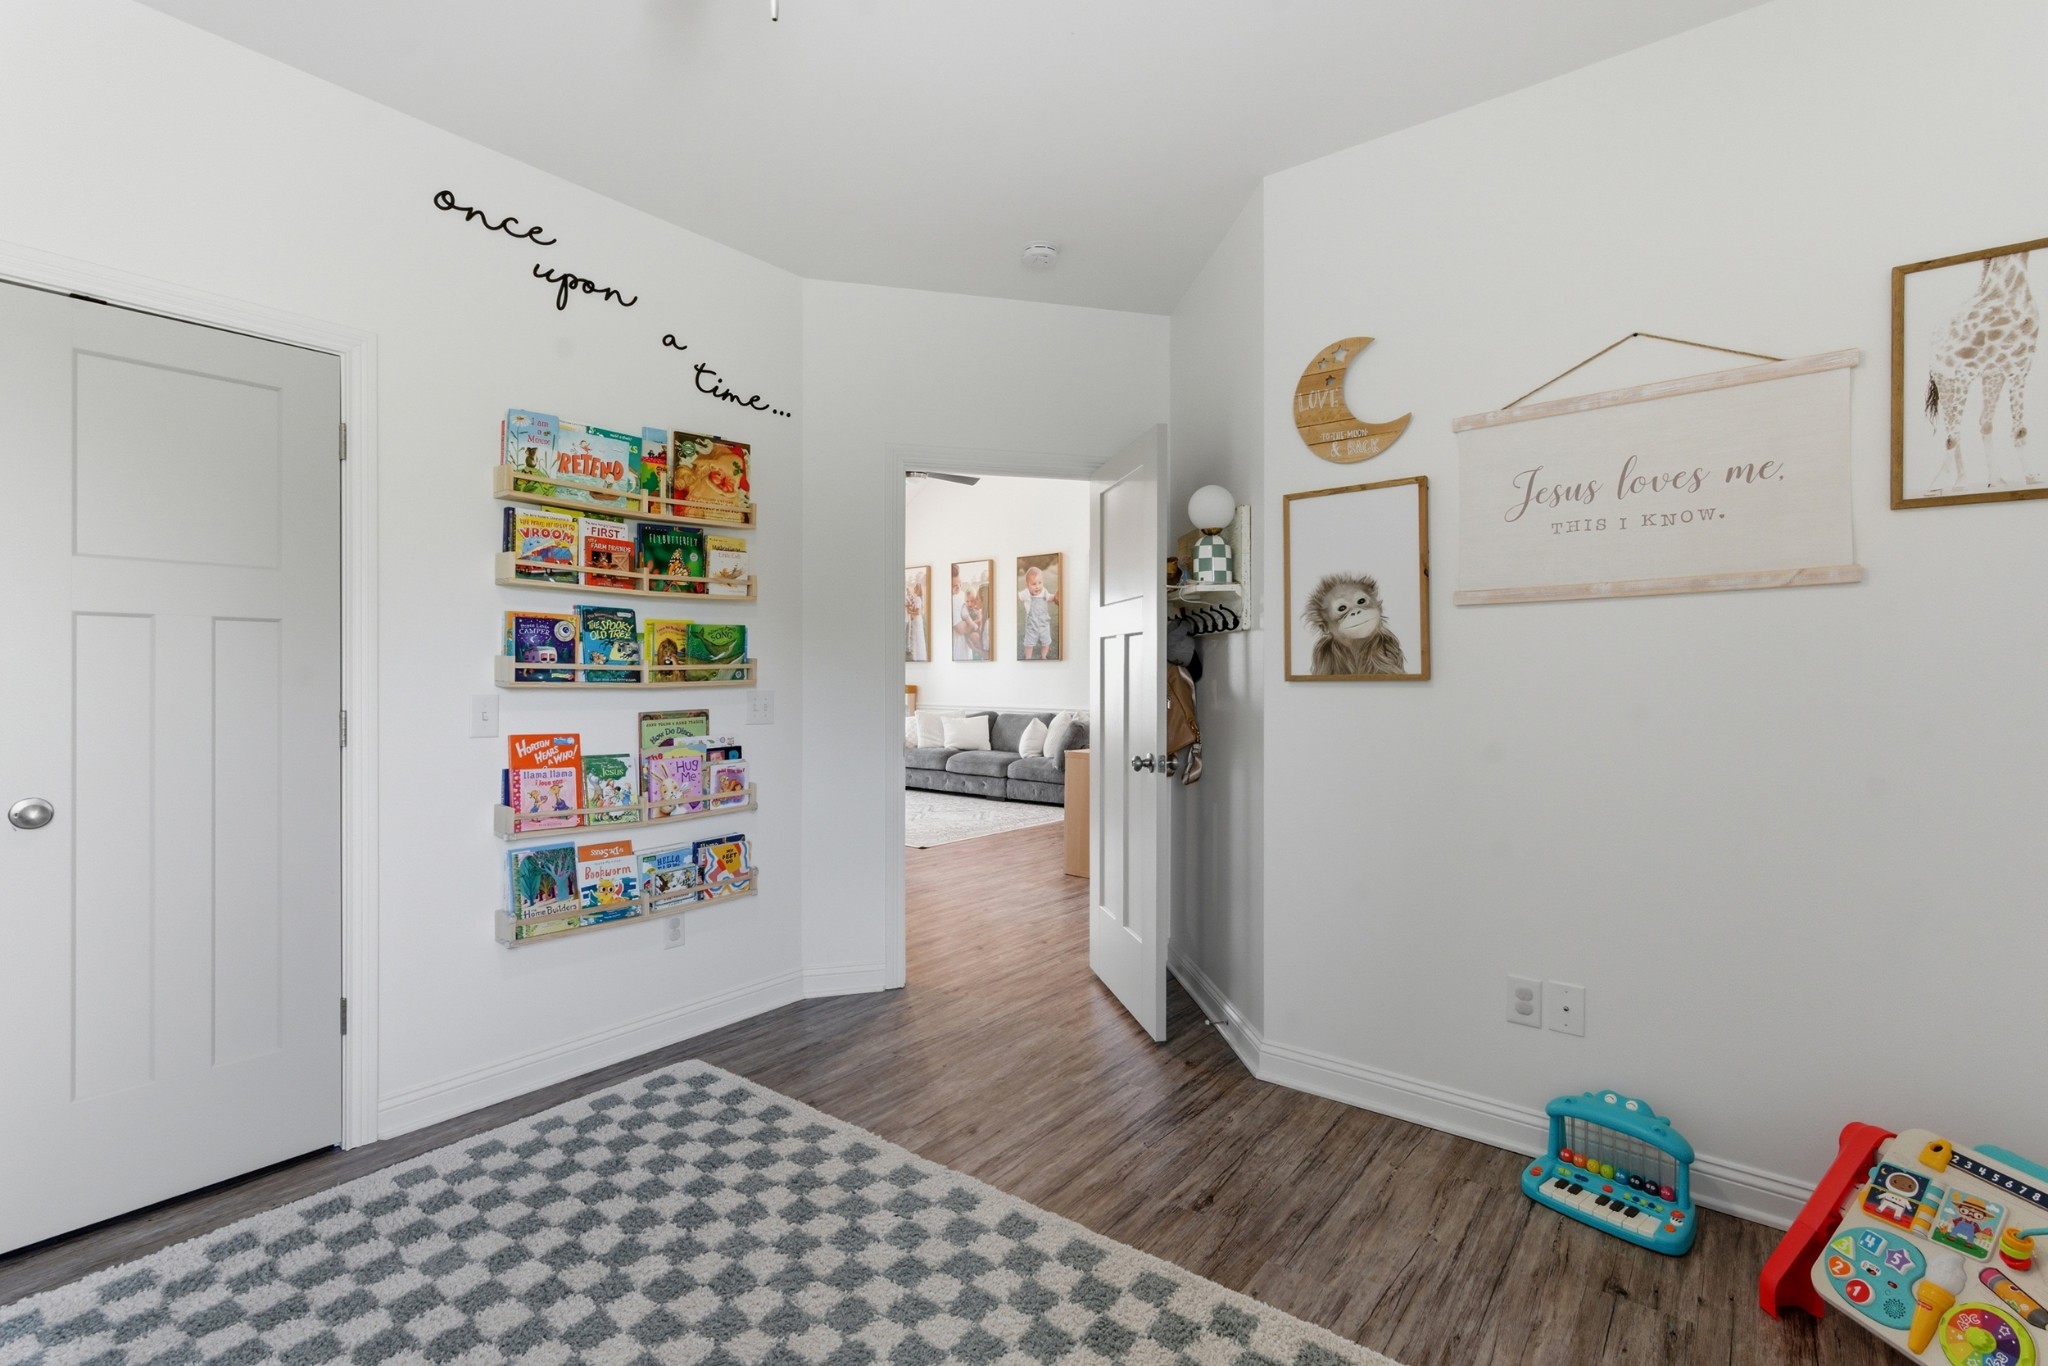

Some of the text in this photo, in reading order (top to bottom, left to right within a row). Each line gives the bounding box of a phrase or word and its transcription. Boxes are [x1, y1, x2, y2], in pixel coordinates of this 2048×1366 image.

[433, 190, 557, 246] once
[533, 263, 638, 311] upon
[662, 334, 688, 350] a
[1298, 389, 1339, 412] LOVE
[1347, 439, 1380, 456] BACK
[1504, 465, 1604, 523] Jesus
[1617, 454, 1711, 501] loves
[591, 527, 620, 538] FIRST
[1551, 518, 1607, 535] THIS
[1619, 517, 1628, 530] I
[519, 527, 575, 544] VROOM
[600, 619, 634, 632] SPOOKY
[590, 630, 631, 640] OLD TREE
[711, 631, 733, 641] SONG
[649, 732, 664, 744] How
[515, 739, 550, 758] HORTON
[534, 746, 559, 764] HEARS
[553, 744, 578, 764] WHO!
[523, 770, 573, 779] llama llama
[600, 768, 624, 777] Jesus
[722, 852, 737, 860] FEET
[585, 866, 632, 880] Bookworm
[524, 904, 577, 919] Home Builders
[1952, 1155, 2041, 1201] 2 3 4 5 6 7 8
[1838, 1239, 1848, 1251] 3
[1865, 1234, 1876, 1248] 4
[1890, 1253, 1902, 1264] 5
[1832, 1260, 1844, 1274] 2
[1852, 1286, 1861, 1297] 1
[1956, 1313, 1981, 1332] ABC
